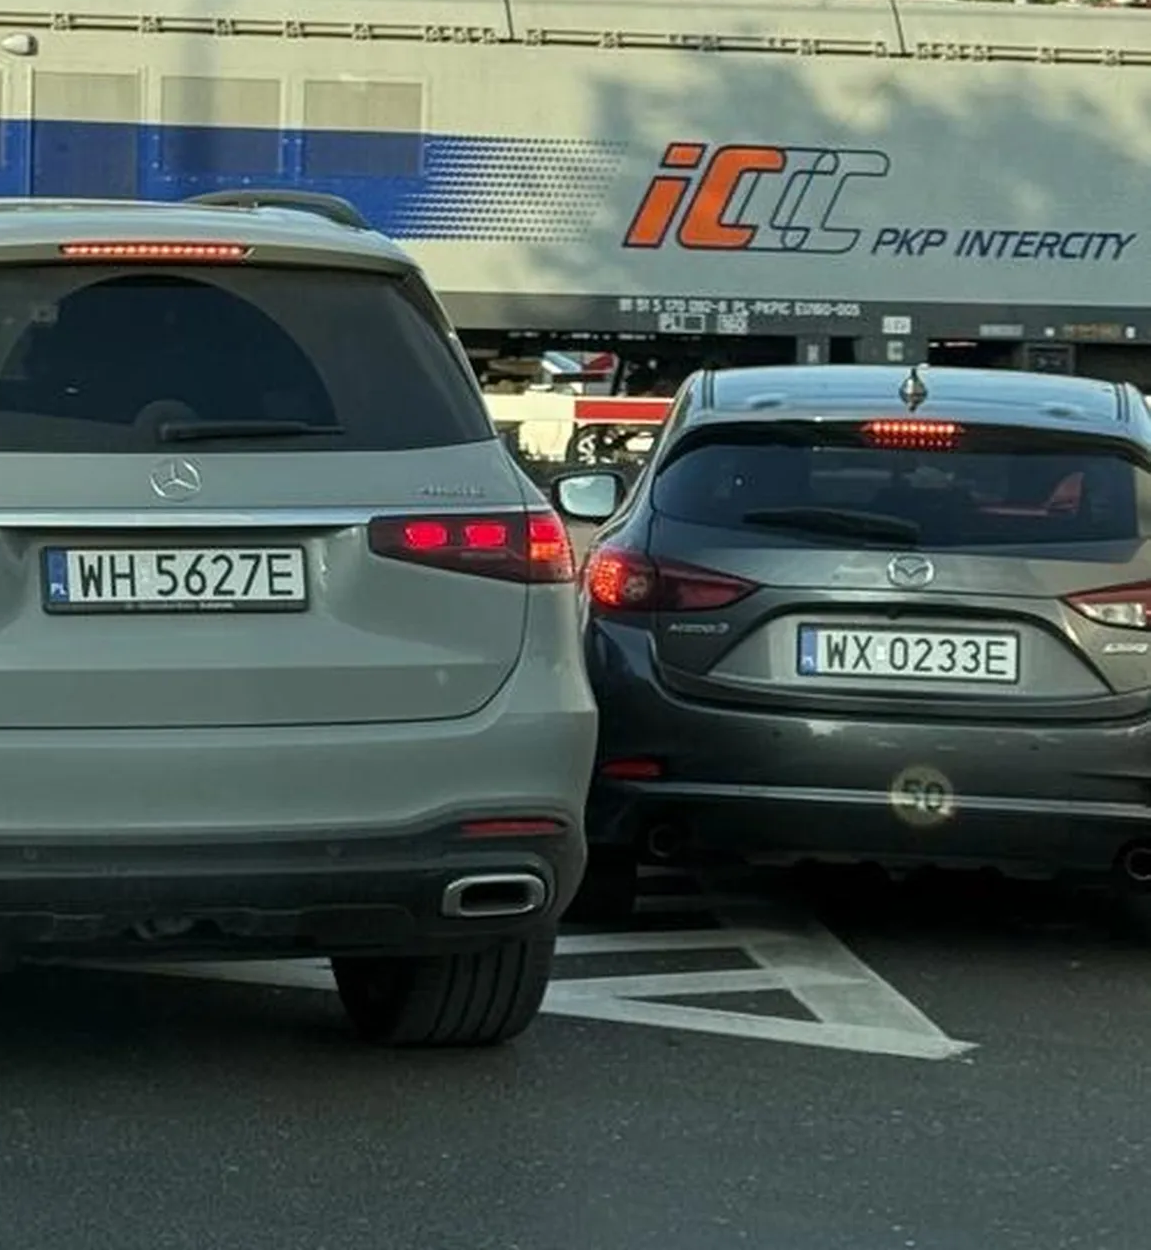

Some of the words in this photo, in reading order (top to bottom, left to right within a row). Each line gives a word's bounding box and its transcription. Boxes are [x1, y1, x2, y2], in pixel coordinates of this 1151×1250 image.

[870, 227, 948, 256] PKP
[954, 230, 1137, 260] INTERCITY
[78, 554, 137, 598] WH
[156, 554, 294, 597] 5627E
[826, 635, 872, 671] WX
[889, 638, 1008, 675] 0233E
